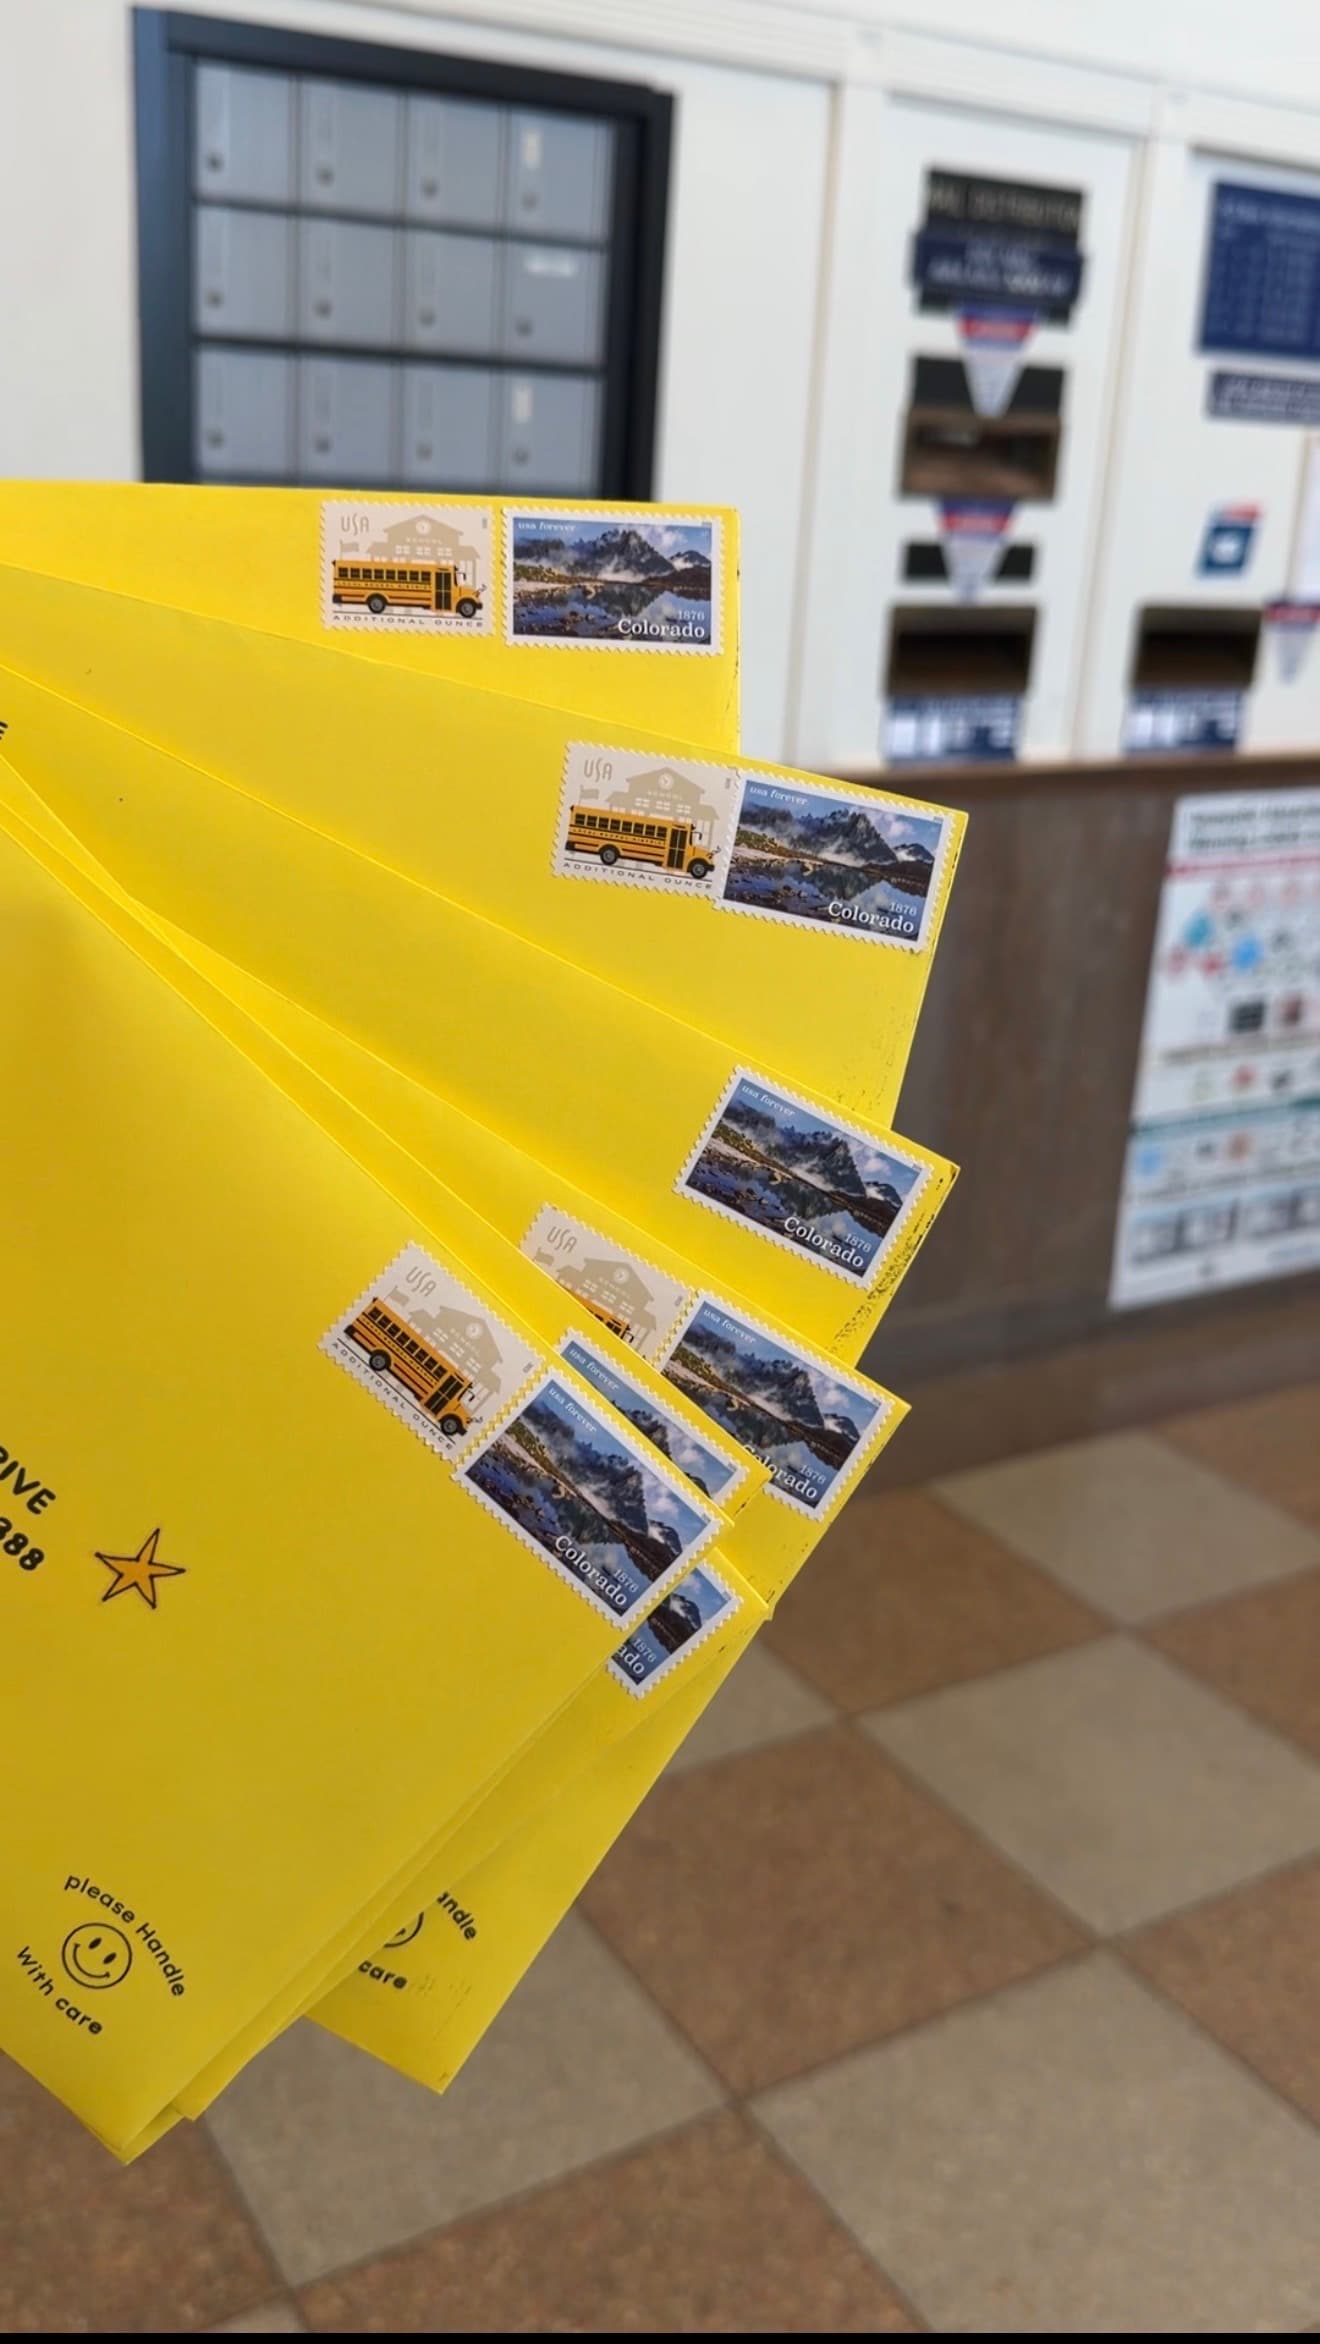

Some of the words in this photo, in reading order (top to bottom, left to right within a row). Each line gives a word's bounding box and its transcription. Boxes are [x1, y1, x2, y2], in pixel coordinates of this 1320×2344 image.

[341, 513, 369, 536] USA
[517, 521, 536, 530] usa
[539, 521, 576, 532] forever
[333, 615, 425, 625] ADDITIONAL
[434, 619, 483, 627] OUNCE
[617, 618, 705, 639] Colorado
[584, 757, 613, 783] USA
[749, 786, 769, 797] usa
[770, 788, 808, 805] forever
[563, 862, 656, 882] ADDITIONAL
[664, 877, 713, 890] OUNCE
[828, 901, 914, 933] Colorado
[889, 900, 918, 917] 1876
[741, 1085, 759, 1100] usa
[760, 1091, 797, 1117] forever
[547, 1226, 578, 1253] USA
[784, 1216, 865, 1269] Colorado
[845, 1232, 872, 1254] 1876
[405, 1266, 437, 1298] USA
[703, 1309, 722, 1324] usa
[722, 1318, 757, 1344] forever
[568, 1348, 588, 1365] usa
[586, 1359, 621, 1392] forever
[332, 1342, 406, 1410] ADDITIONAL
[412, 1413, 454, 1449] OUNCE
[548, 1387, 566, 1405] usa
[564, 1401, 597, 1434] forever
[799, 1464, 826, 1485] 1876
[554, 1534, 628, 1606] Colorado
[613, 1568, 639, 1594] 1876
[632, 1638, 657, 1663] 1876
[64, 1875, 135, 1923] please
[136, 1922, 185, 1997] Handle
[358, 1960, 408, 1989] care
[17, 1946, 54, 1996] With
[55, 1998, 103, 2035] care
